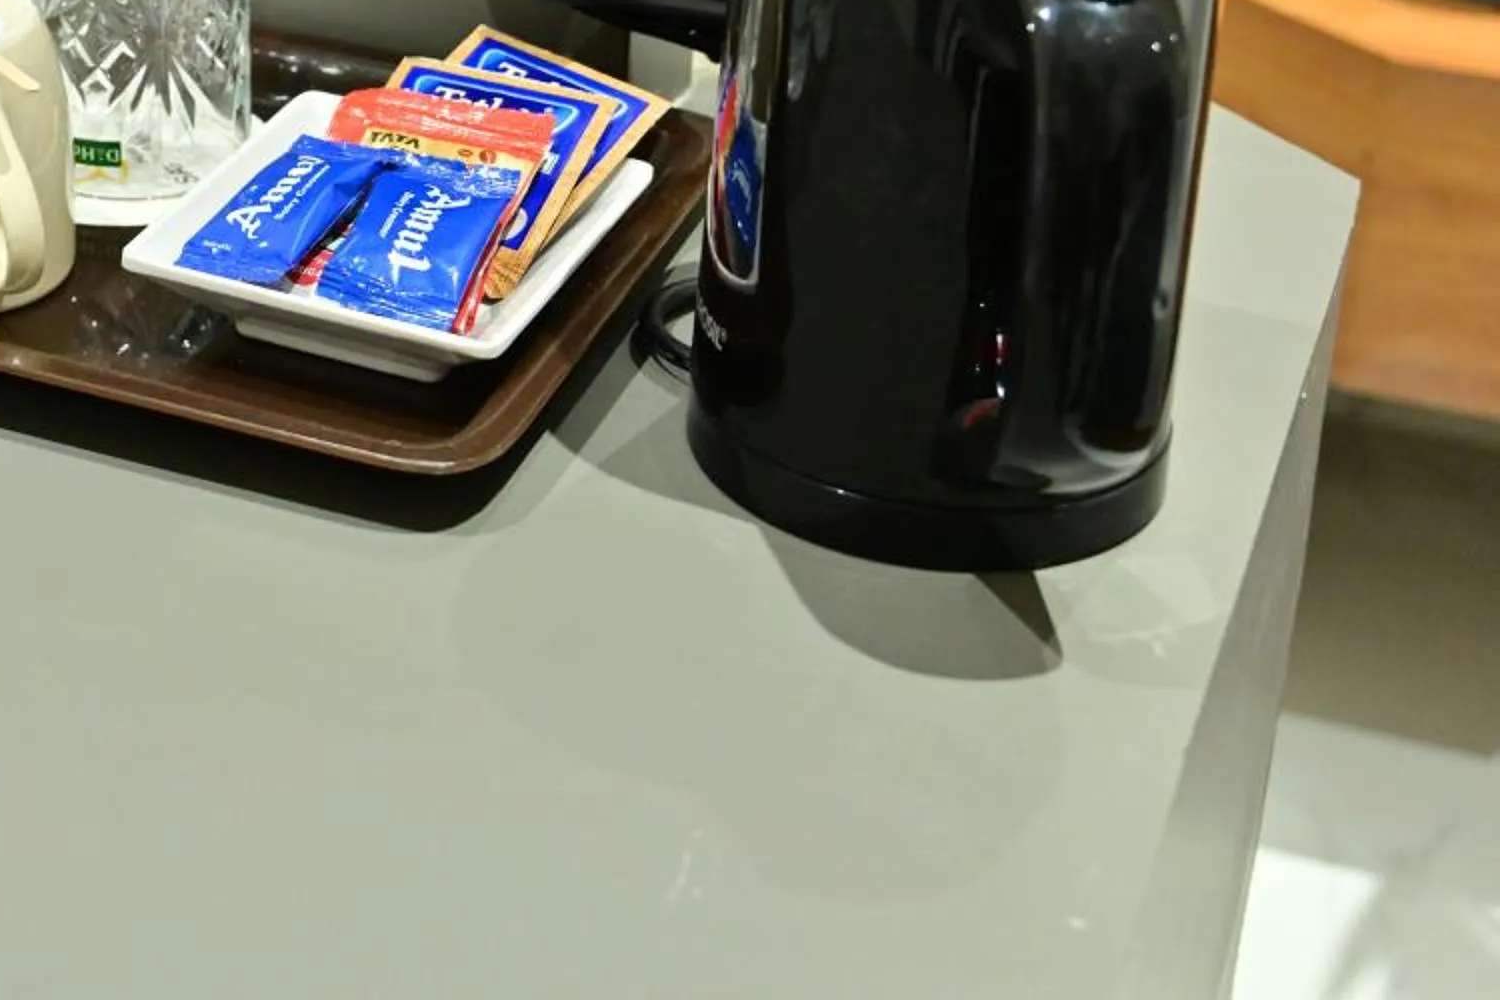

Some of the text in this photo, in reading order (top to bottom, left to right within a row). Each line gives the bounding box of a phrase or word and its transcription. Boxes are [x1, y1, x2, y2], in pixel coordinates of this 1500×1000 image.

[369, 130, 422, 150] TATA
[225, 155, 325, 240] Amul
[386, 183, 472, 287] Amul
